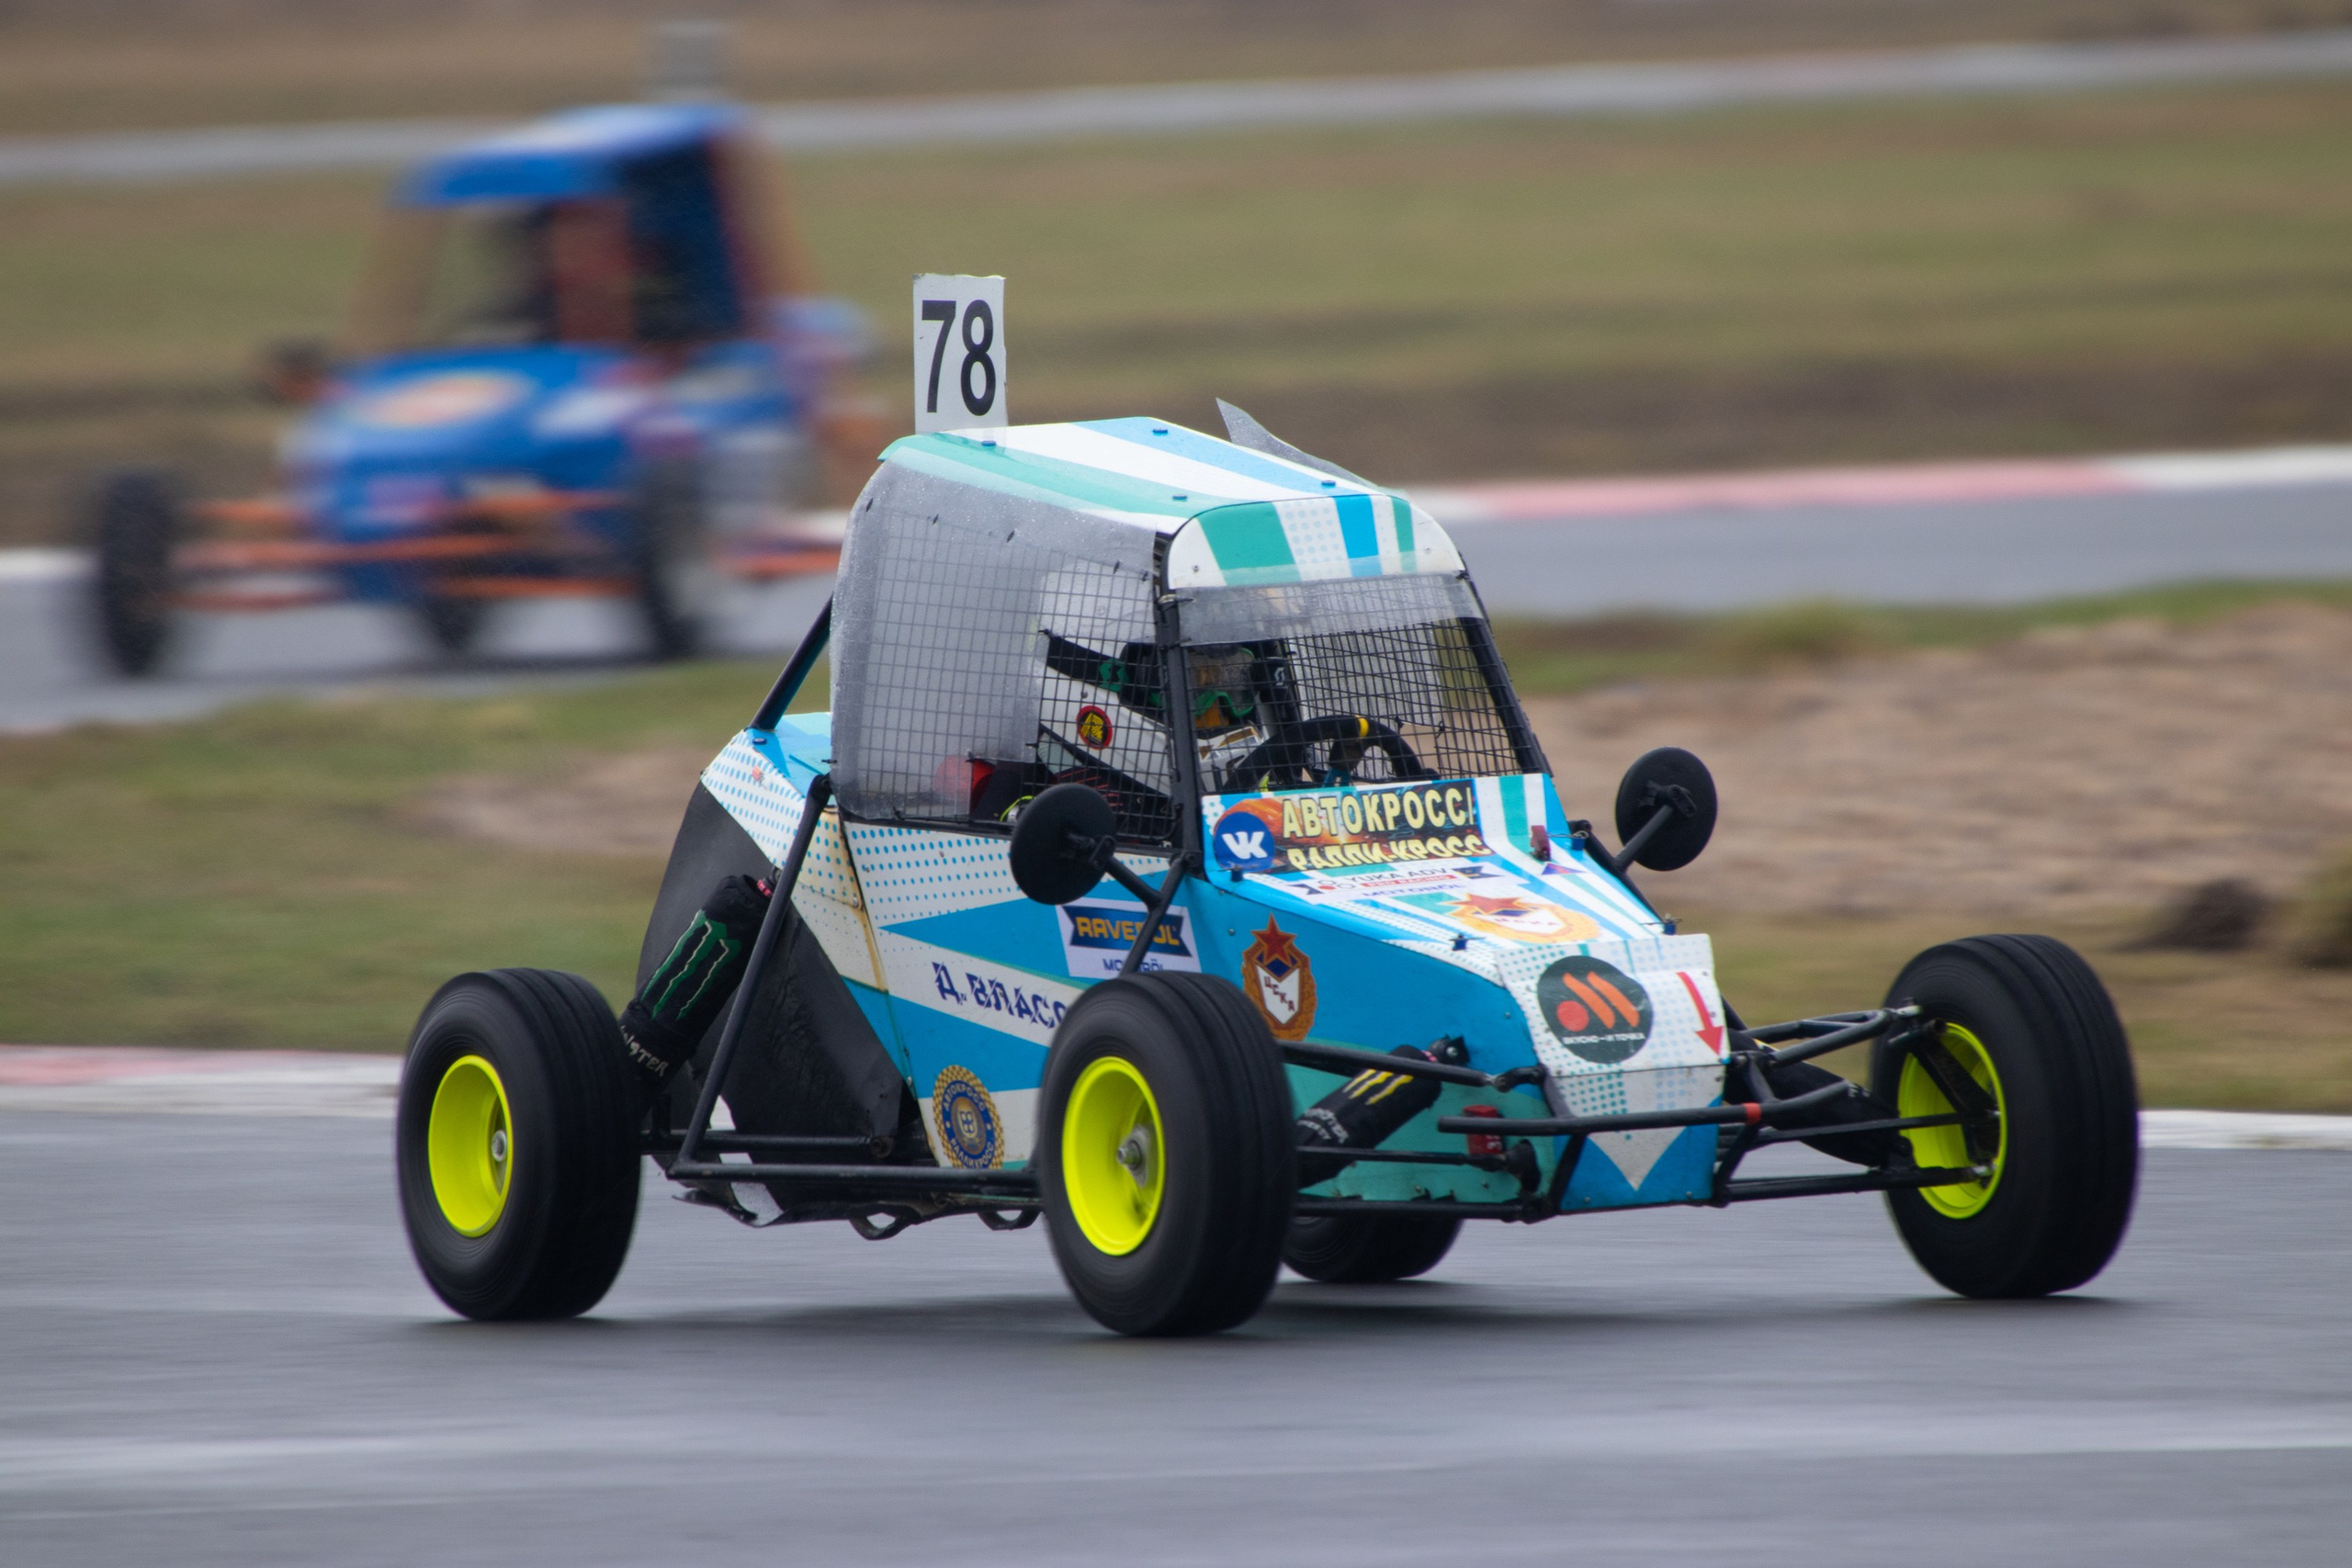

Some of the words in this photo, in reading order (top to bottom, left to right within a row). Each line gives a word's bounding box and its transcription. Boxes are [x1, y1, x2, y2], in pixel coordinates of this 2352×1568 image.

[922, 299, 997, 416] 78
[1286, 834, 1492, 871] РАЛЛИ-КРОСС
[620, 1024, 669, 1077] NSTER
